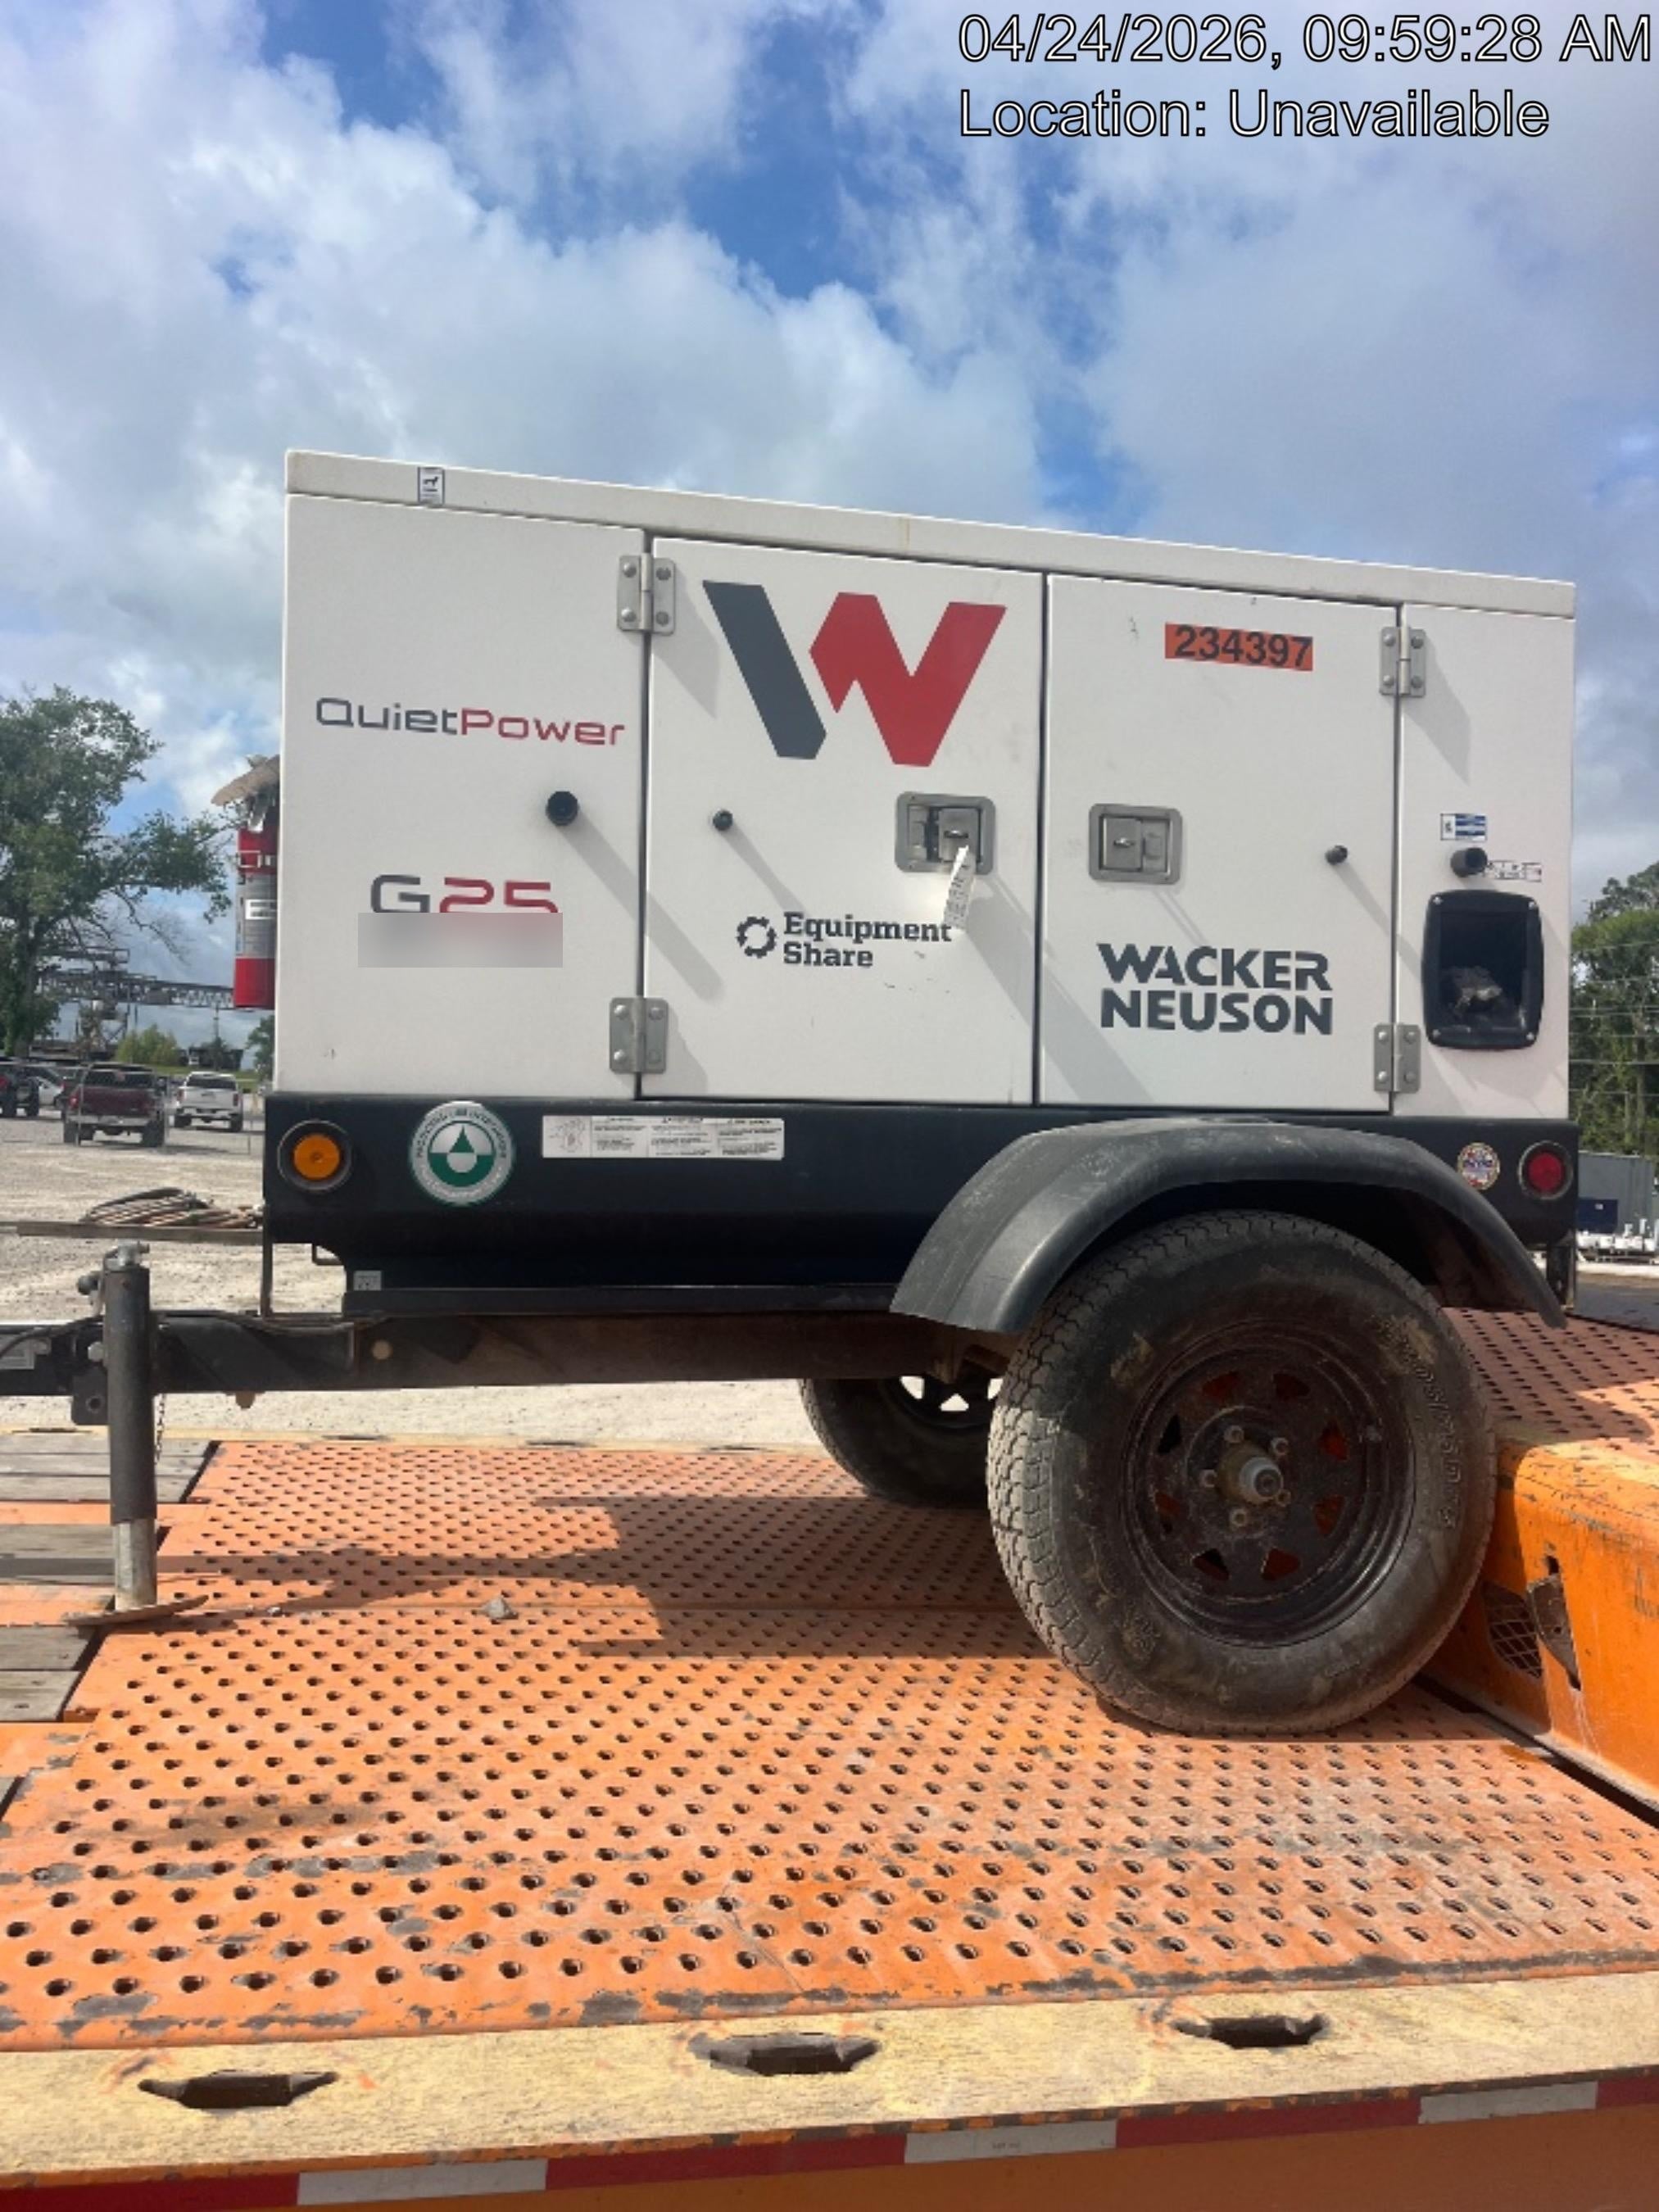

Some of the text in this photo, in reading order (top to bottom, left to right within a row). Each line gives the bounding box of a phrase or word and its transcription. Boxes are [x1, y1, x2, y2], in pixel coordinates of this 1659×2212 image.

[1176, 623, 1312, 668] 234397
[316, 696, 625, 746] QuietPower
[370, 874, 559, 913] G25
[784, 912, 952, 944] Equipment
[784, 941, 873, 968] Share
[1098, 943, 1332, 991] WACKER
[1101, 989, 1333, 1036] NEUSON
